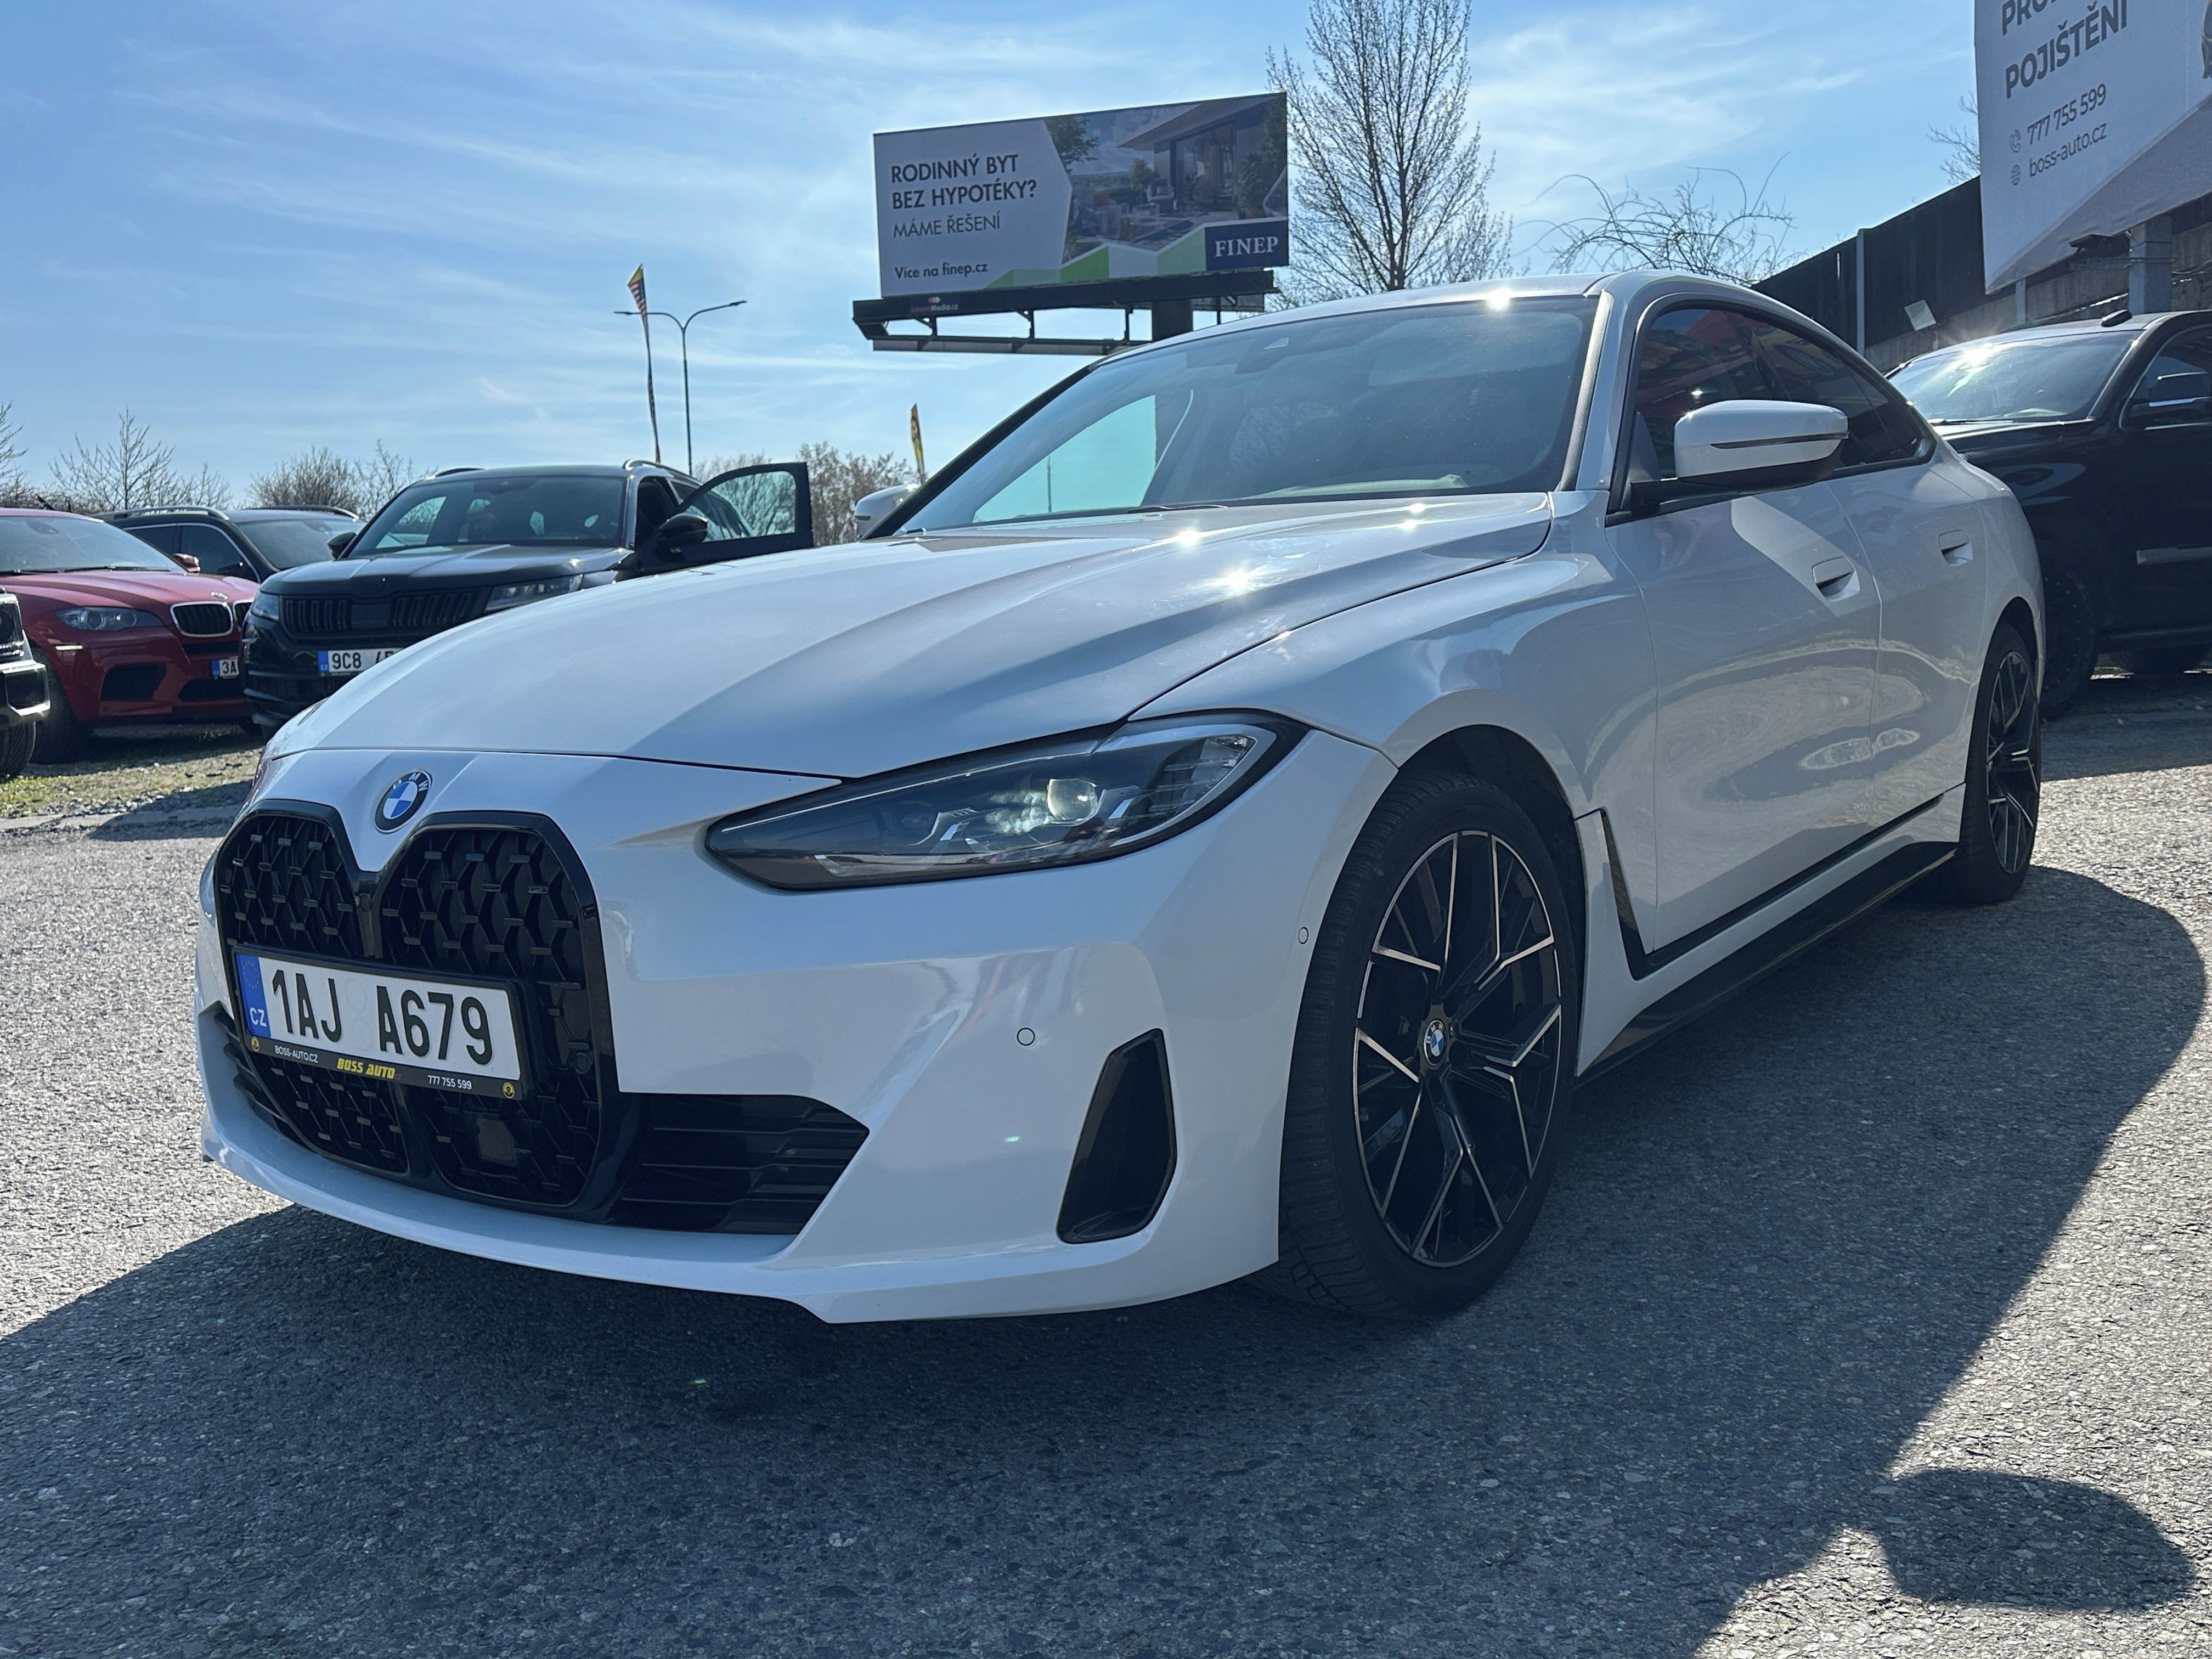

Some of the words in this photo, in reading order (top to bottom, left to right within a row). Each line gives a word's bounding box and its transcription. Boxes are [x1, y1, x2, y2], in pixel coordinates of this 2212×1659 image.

[2028, 114, 2050, 145] 777
[2053, 99, 2076, 130] 755
[2080, 83, 2106, 115] 599
[2029, 123, 2107, 177] boss-auto.cz
[891, 153, 979, 183] RODINNÝ
[986, 154, 1018, 174] BYT
[893, 190, 925, 210] BEZ
[933, 178, 1037, 206] HYPOTÉKY?
[893, 218, 941, 238] MÁME
[947, 211, 1000, 233] ŘEŠENÍ
[1215, 236, 1278, 257] FINEP
[894, 266, 919, 278] Více
[923, 268, 938, 276] na
[943, 262, 988, 277] finep.cz
[332, 652, 362, 669] 9C8
[250, 1007, 267, 1027] CZ
[272, 969, 342, 1042] 1AJ
[376, 985, 493, 1065] A679
[275, 1045, 318, 1063] BOSS-AUTO.CZ
[336, 1058, 363, 1074] BOSS
[365, 1064, 396, 1079] AUTO
[427, 1075, 439, 1085] 777
[443, 1077, 455, 1088] 755
[457, 1080, 472, 1090] 599
